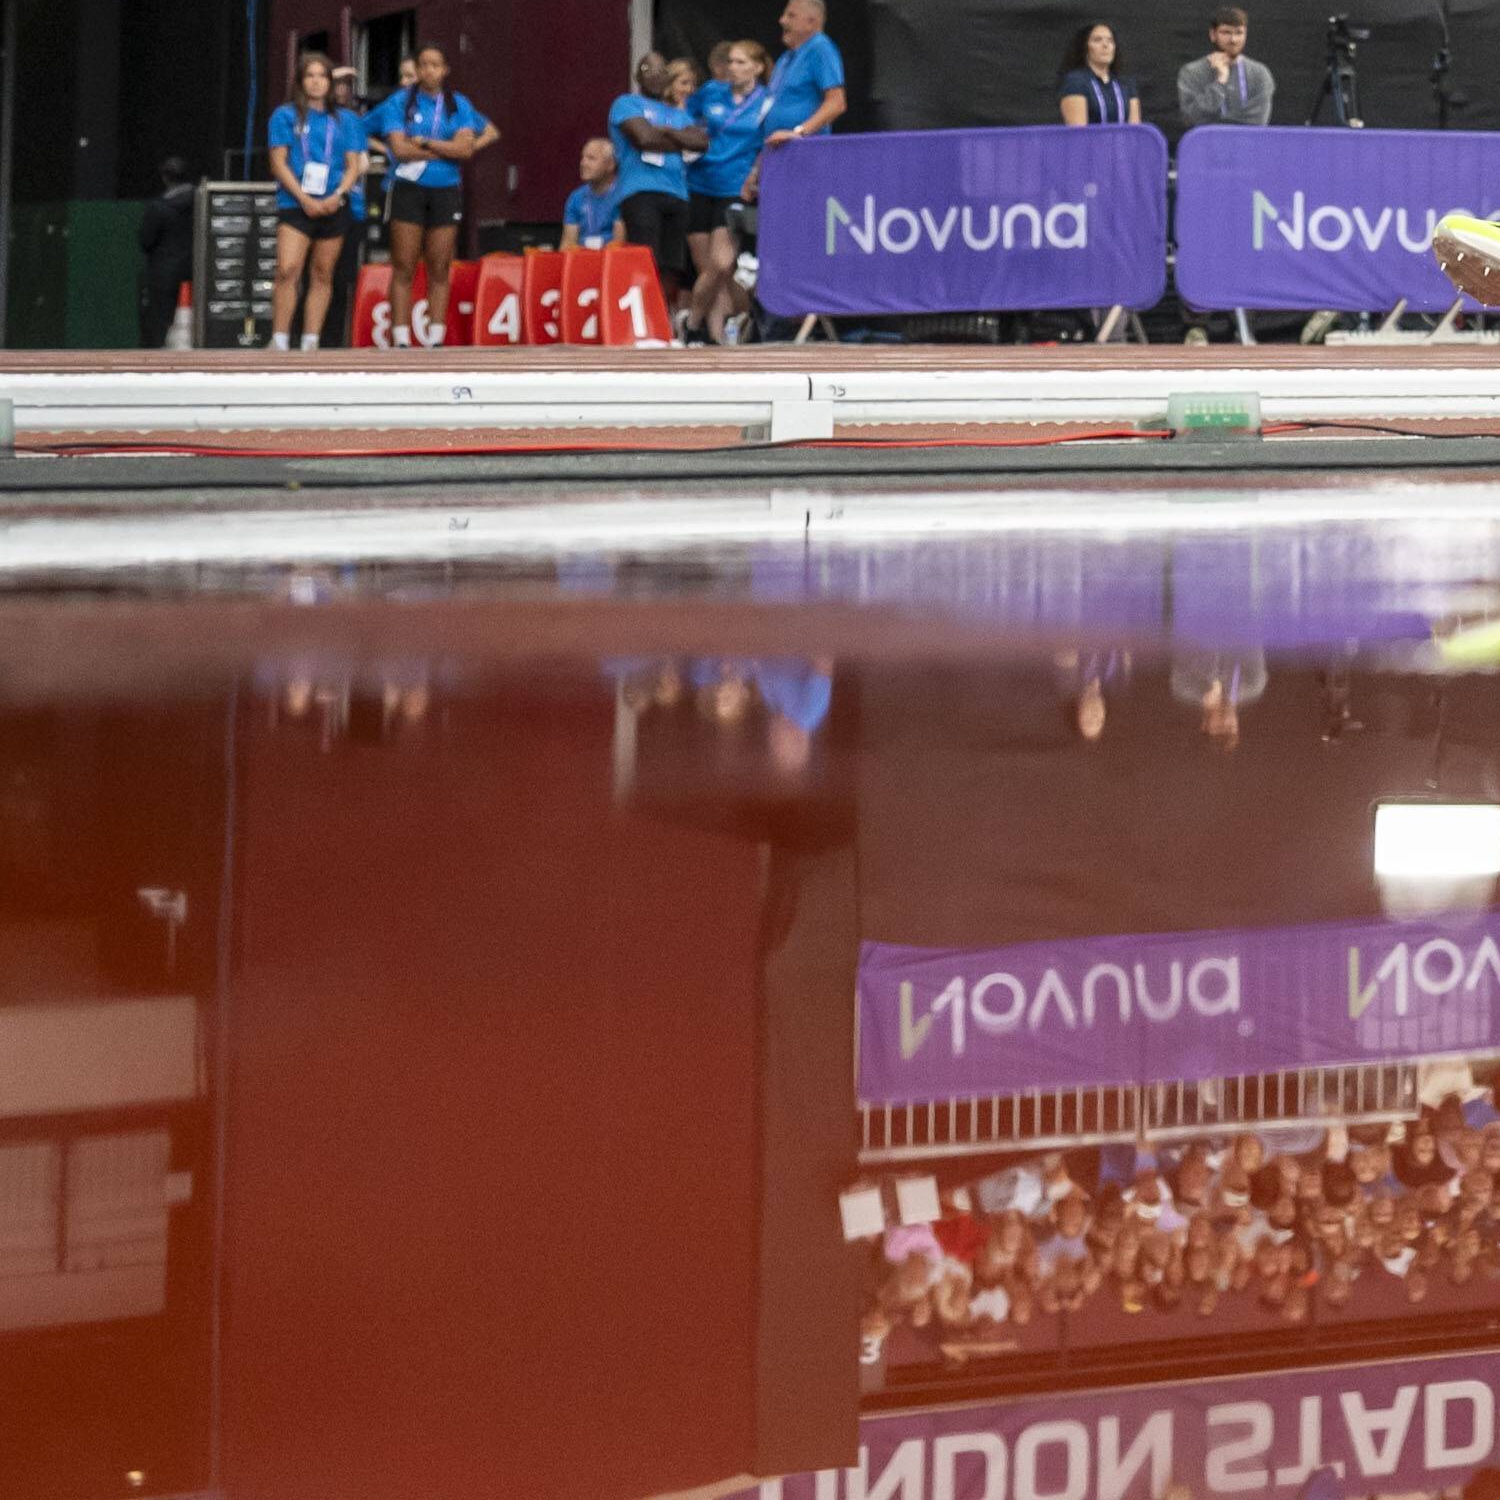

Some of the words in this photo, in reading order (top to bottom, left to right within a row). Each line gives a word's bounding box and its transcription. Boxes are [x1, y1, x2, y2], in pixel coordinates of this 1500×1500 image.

[825, 194, 1088, 255] Novuna
[488, 293, 521, 343] 4
[618, 285, 648, 338] 1
